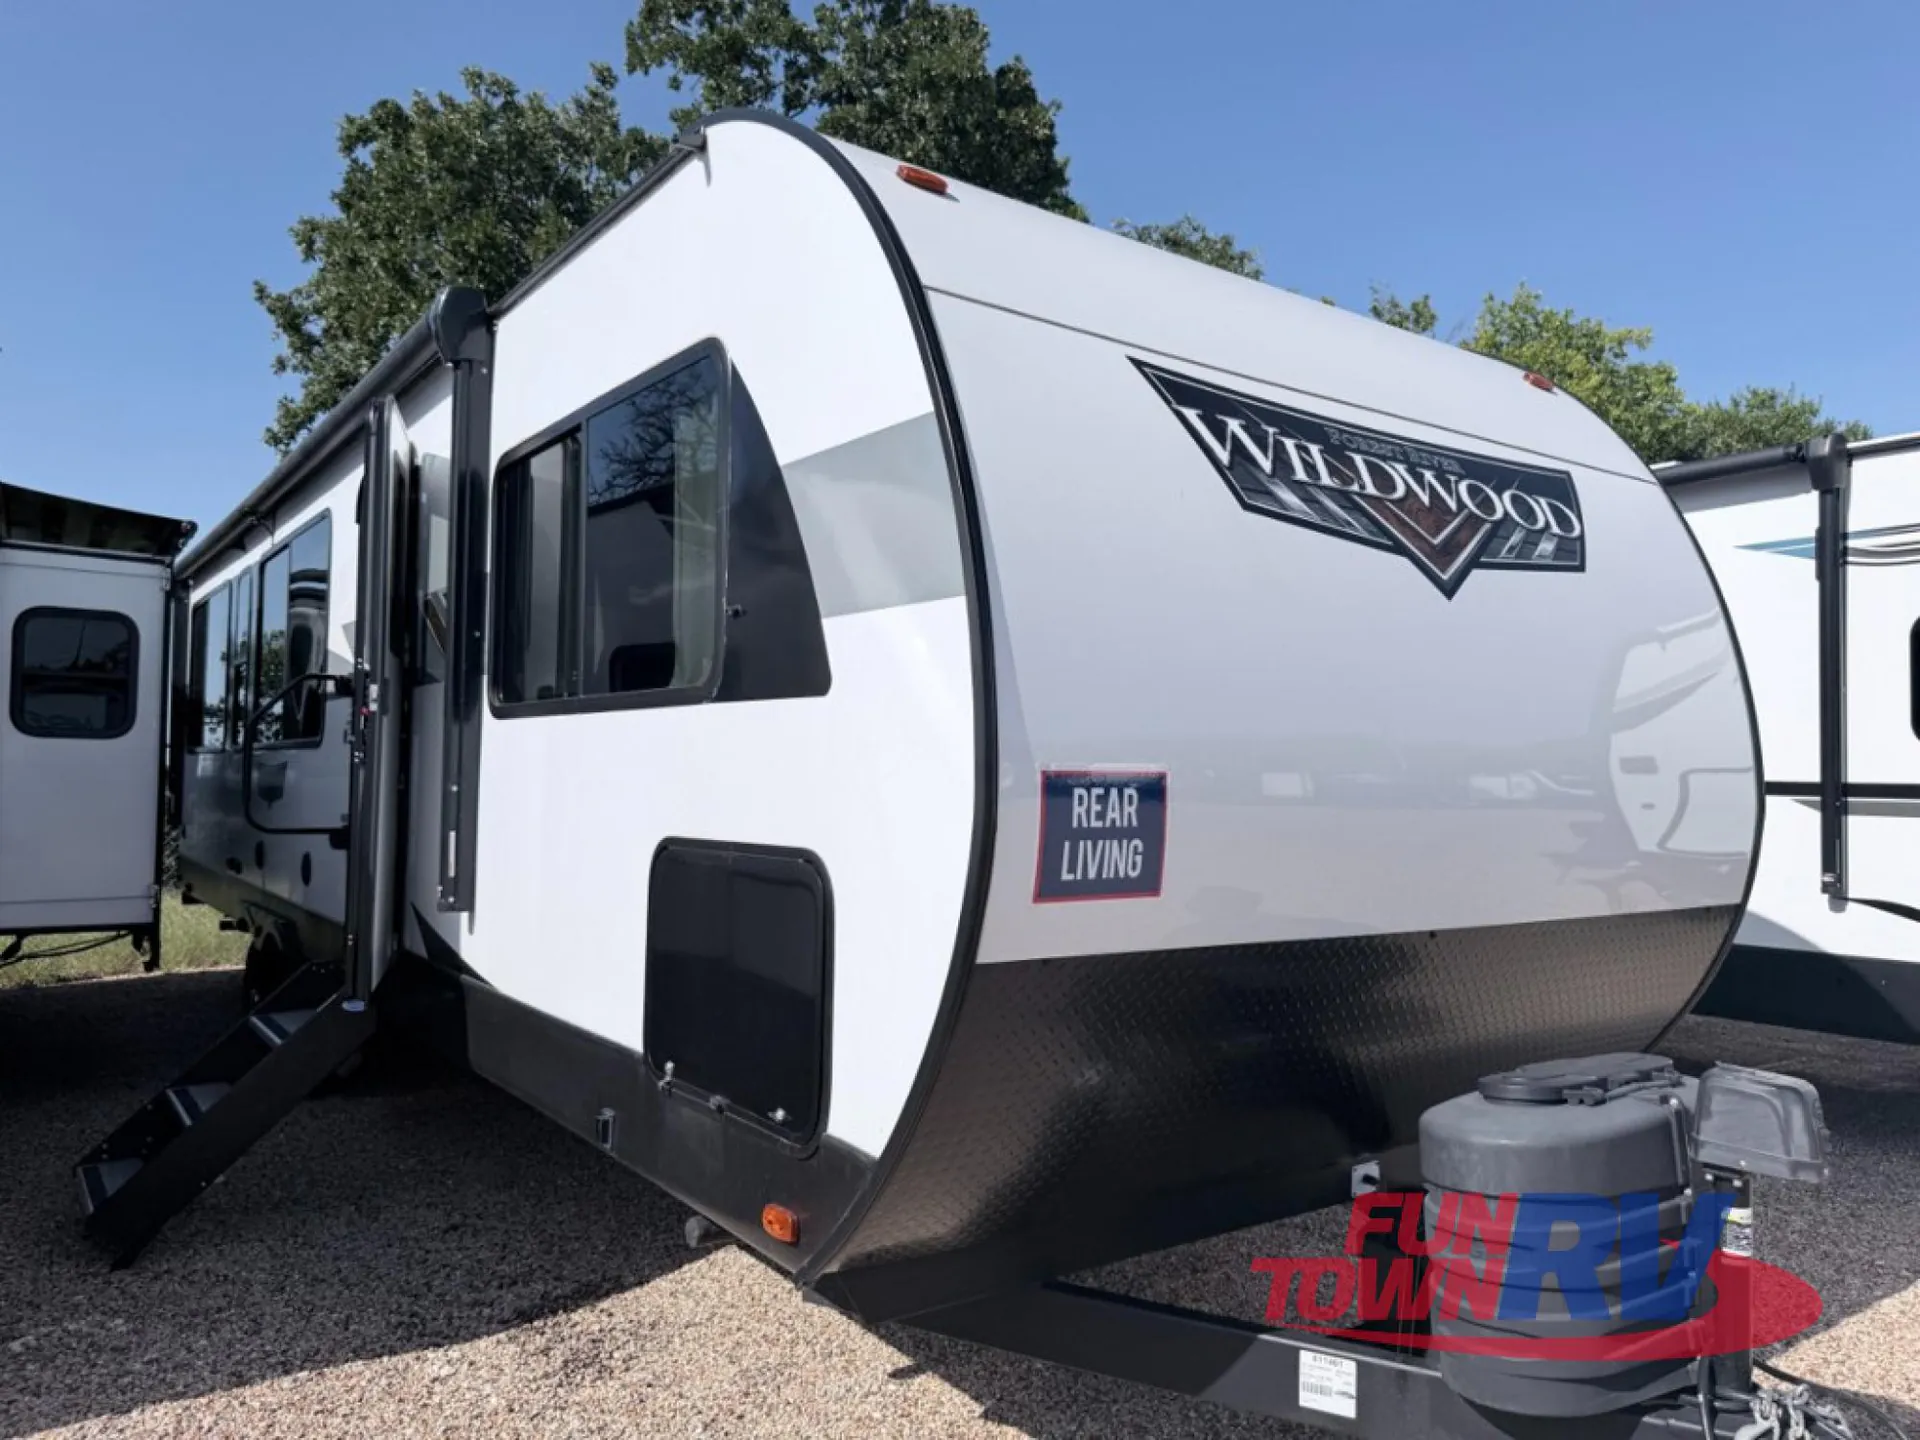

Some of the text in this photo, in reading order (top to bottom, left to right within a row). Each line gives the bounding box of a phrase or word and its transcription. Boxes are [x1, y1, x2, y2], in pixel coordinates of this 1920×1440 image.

[1170, 404, 1583, 539] WILDWOOD
[1071, 786, 1139, 829] REAR
[1060, 837, 1144, 881] LIVING
